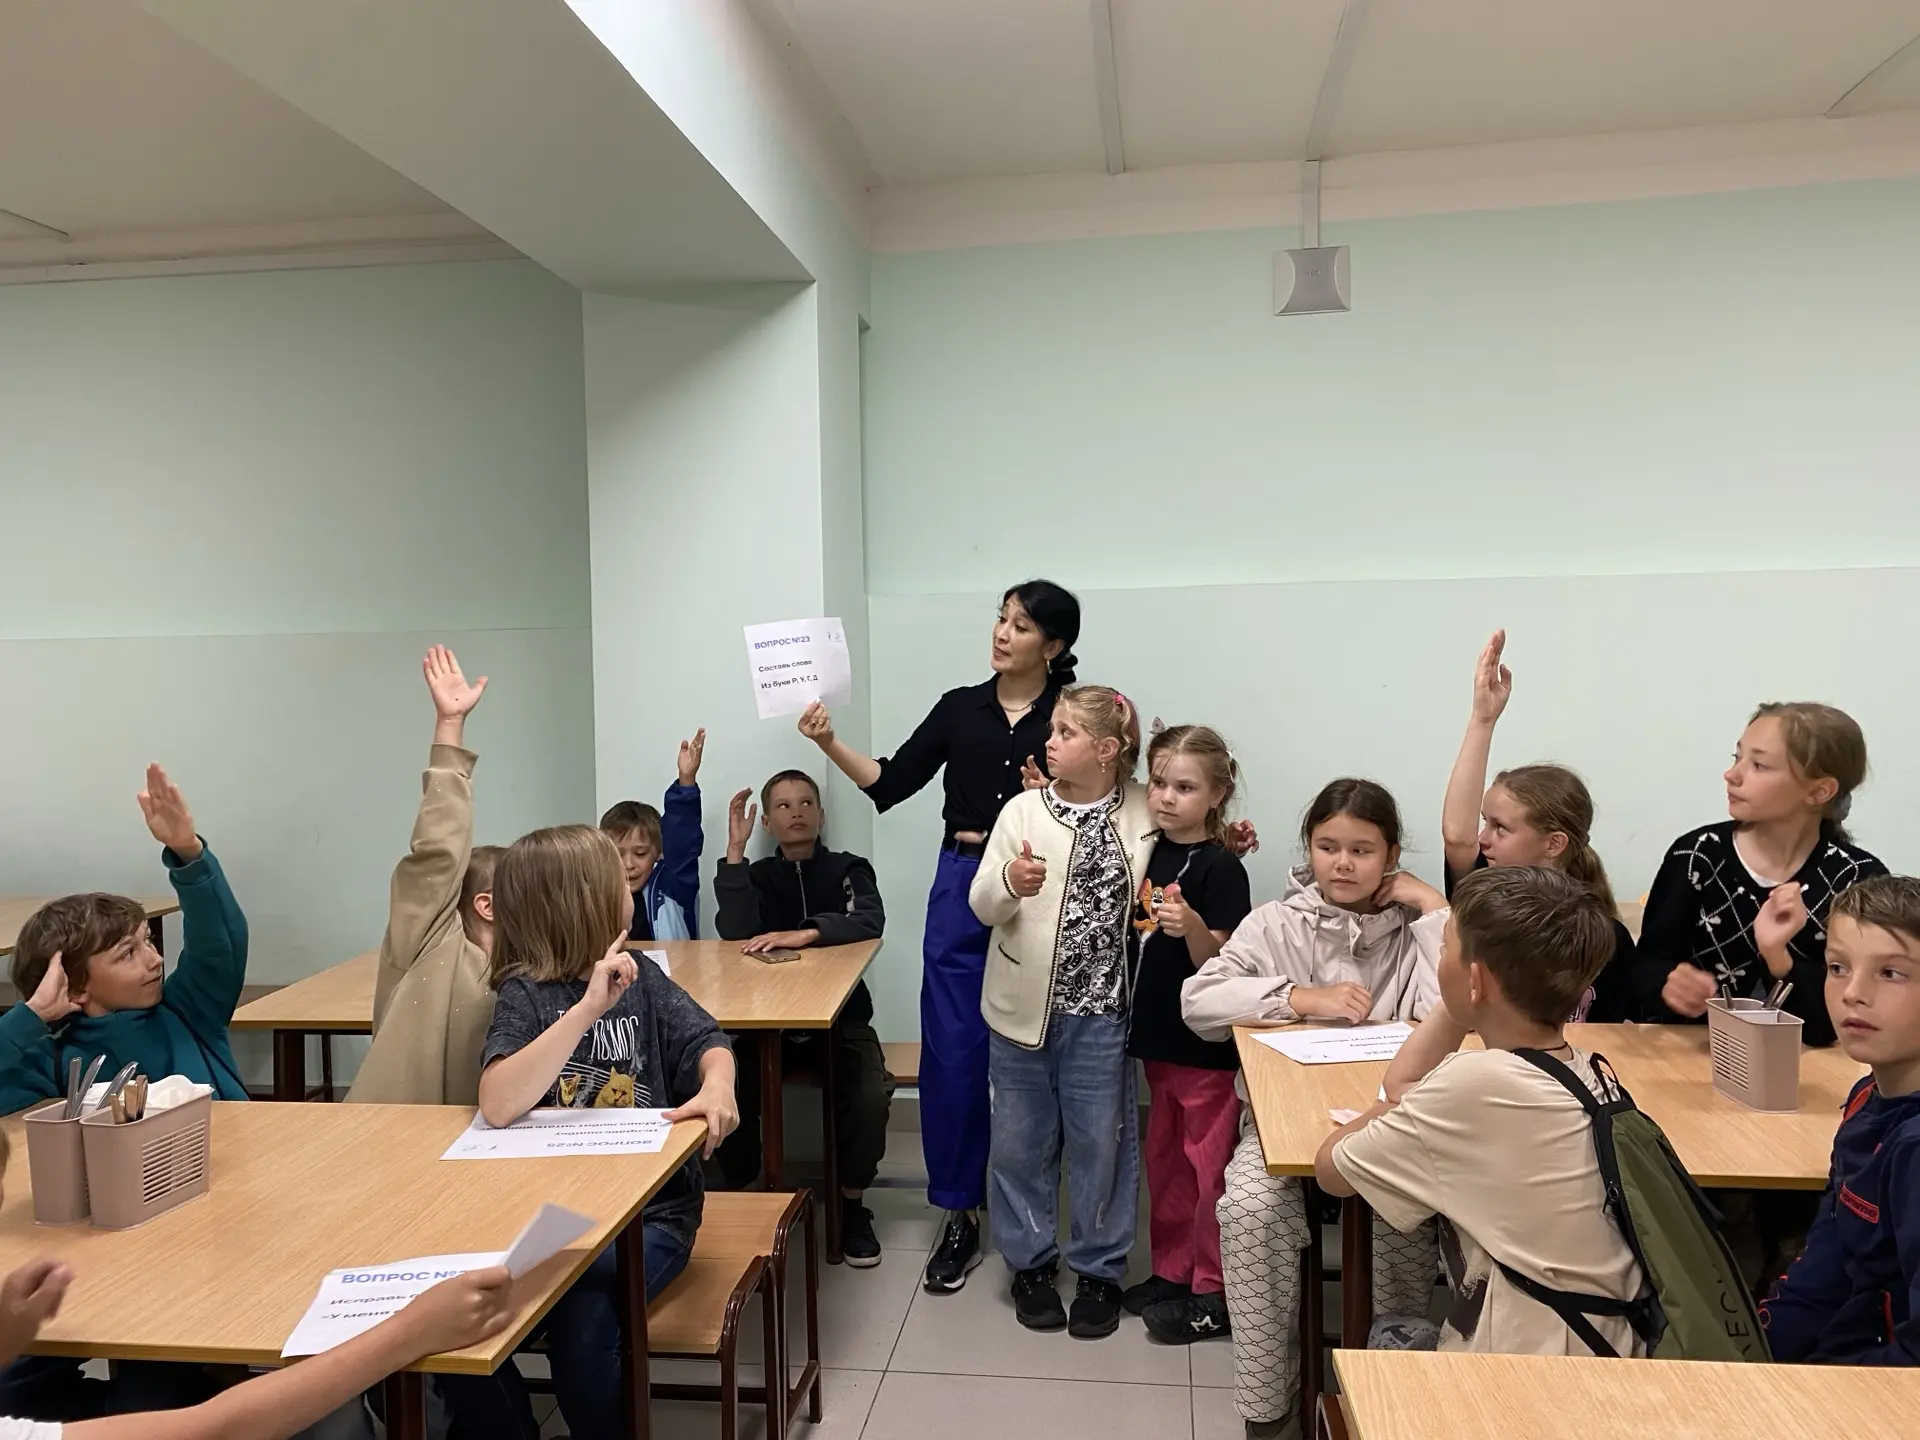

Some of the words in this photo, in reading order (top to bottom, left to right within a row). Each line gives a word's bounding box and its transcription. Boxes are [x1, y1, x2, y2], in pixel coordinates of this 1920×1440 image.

[754, 637, 791, 650] ВОПРОС
[791, 635, 811, 644] №23
[758, 662, 791, 673] Составь
[791, 659, 813, 668] слово
[761, 682, 772, 690] Из
[772, 679, 791, 689] букв
[341, 1271, 430, 1284] ВОПРОС
[330, 1296, 407, 1305] Исправь
[343, 1310, 390, 1318] меня
